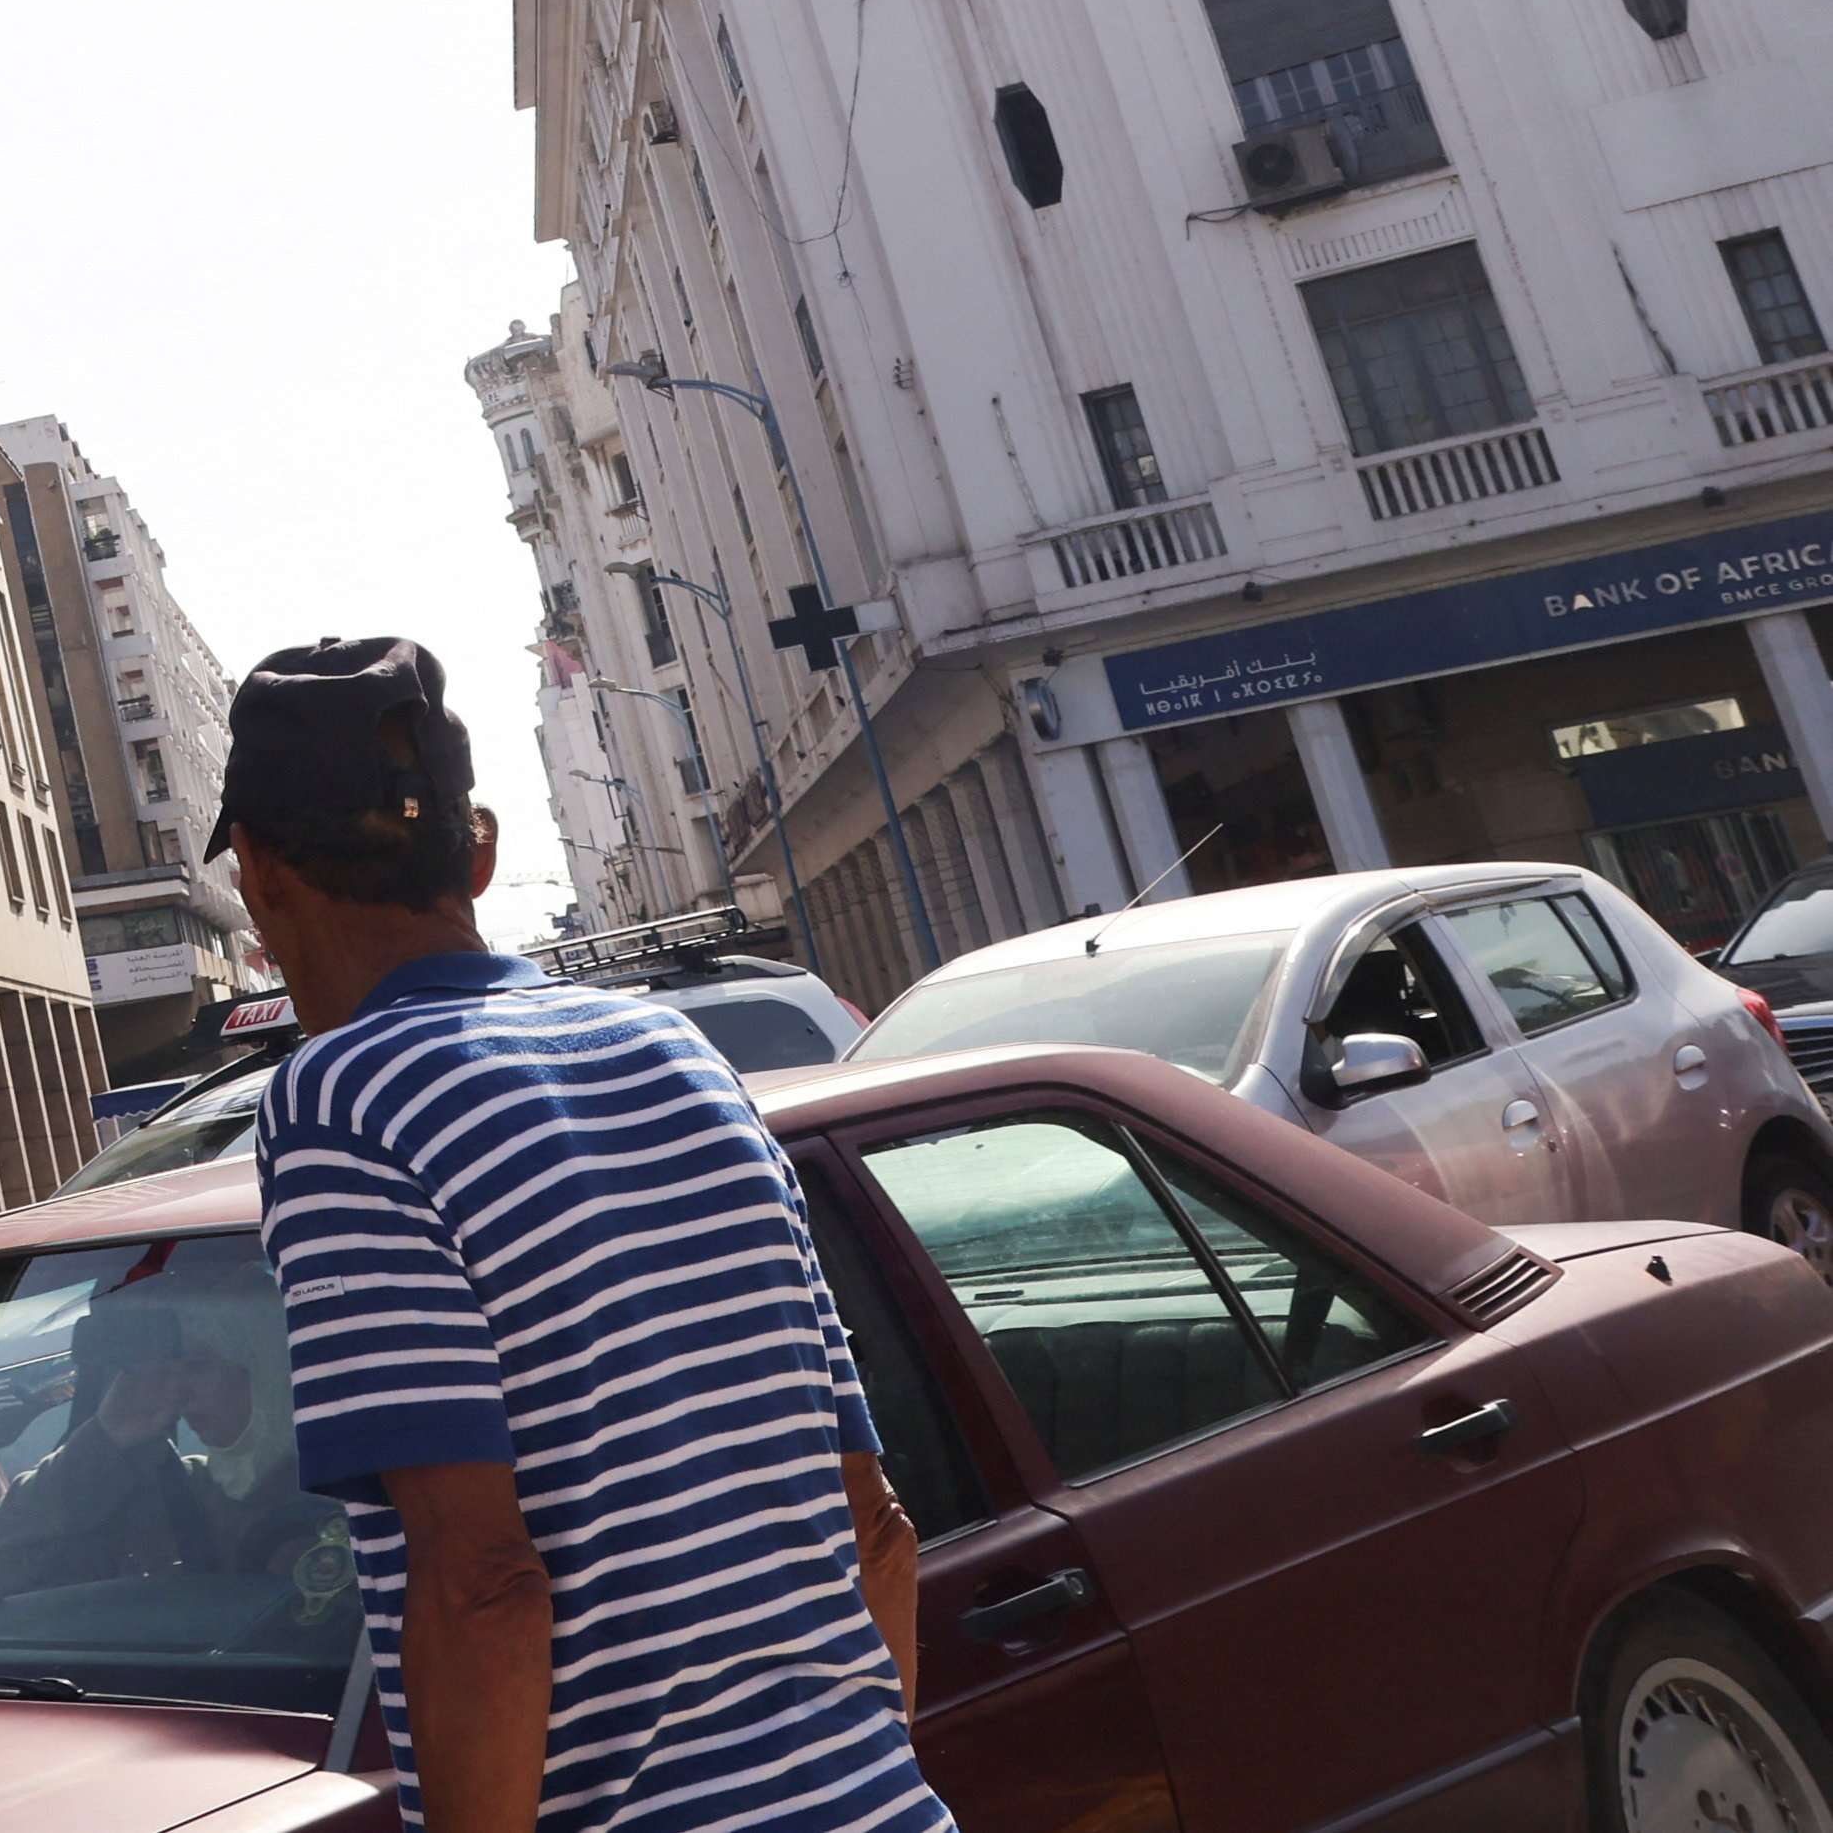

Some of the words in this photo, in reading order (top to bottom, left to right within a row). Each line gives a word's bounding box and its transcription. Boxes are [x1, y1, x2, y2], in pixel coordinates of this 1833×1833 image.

[1544, 578, 1647, 616] BANK
[1655, 567, 1701, 595] OF
[1718, 544, 1833, 584] AFRIC
[1721, 583, 1782, 604] BMCE
[1246, 652, 1316, 674] بنك
[1139, 660, 1241, 695] أفريقيا
[1714, 753, 1789, 779] BAN
[234, 1001, 282, 1027] TAXI
